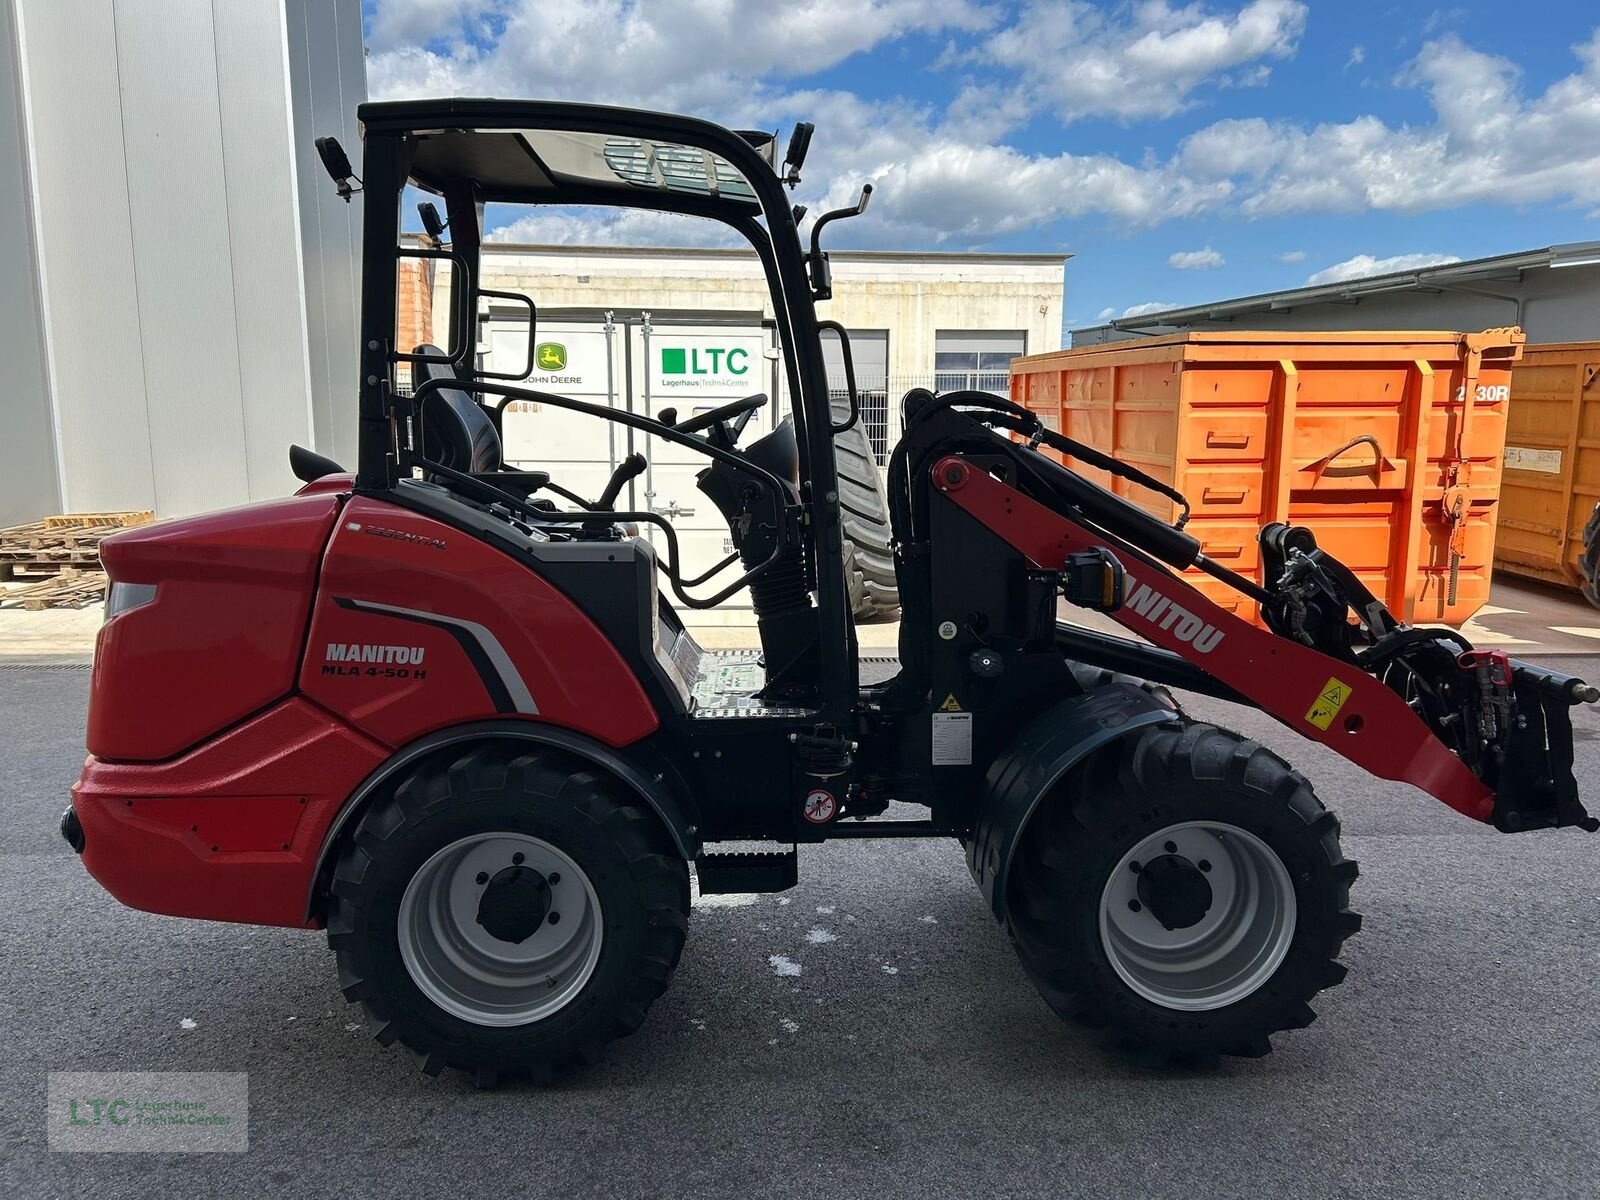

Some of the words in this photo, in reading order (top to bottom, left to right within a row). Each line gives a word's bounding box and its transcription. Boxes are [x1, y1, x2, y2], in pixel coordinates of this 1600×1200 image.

[692, 348, 748, 375] LTC
[550, 375, 582, 384] DEERE
[662, 379, 700, 388] Lagerhaus
[1456, 385, 1509, 402] 230R
[1124, 572, 1227, 654] NITOU
[325, 643, 425, 666] MANITOU
[321, 665, 361, 676] MLA
[365, 667, 410, 679] 4-50
[413, 670, 427, 680] H
